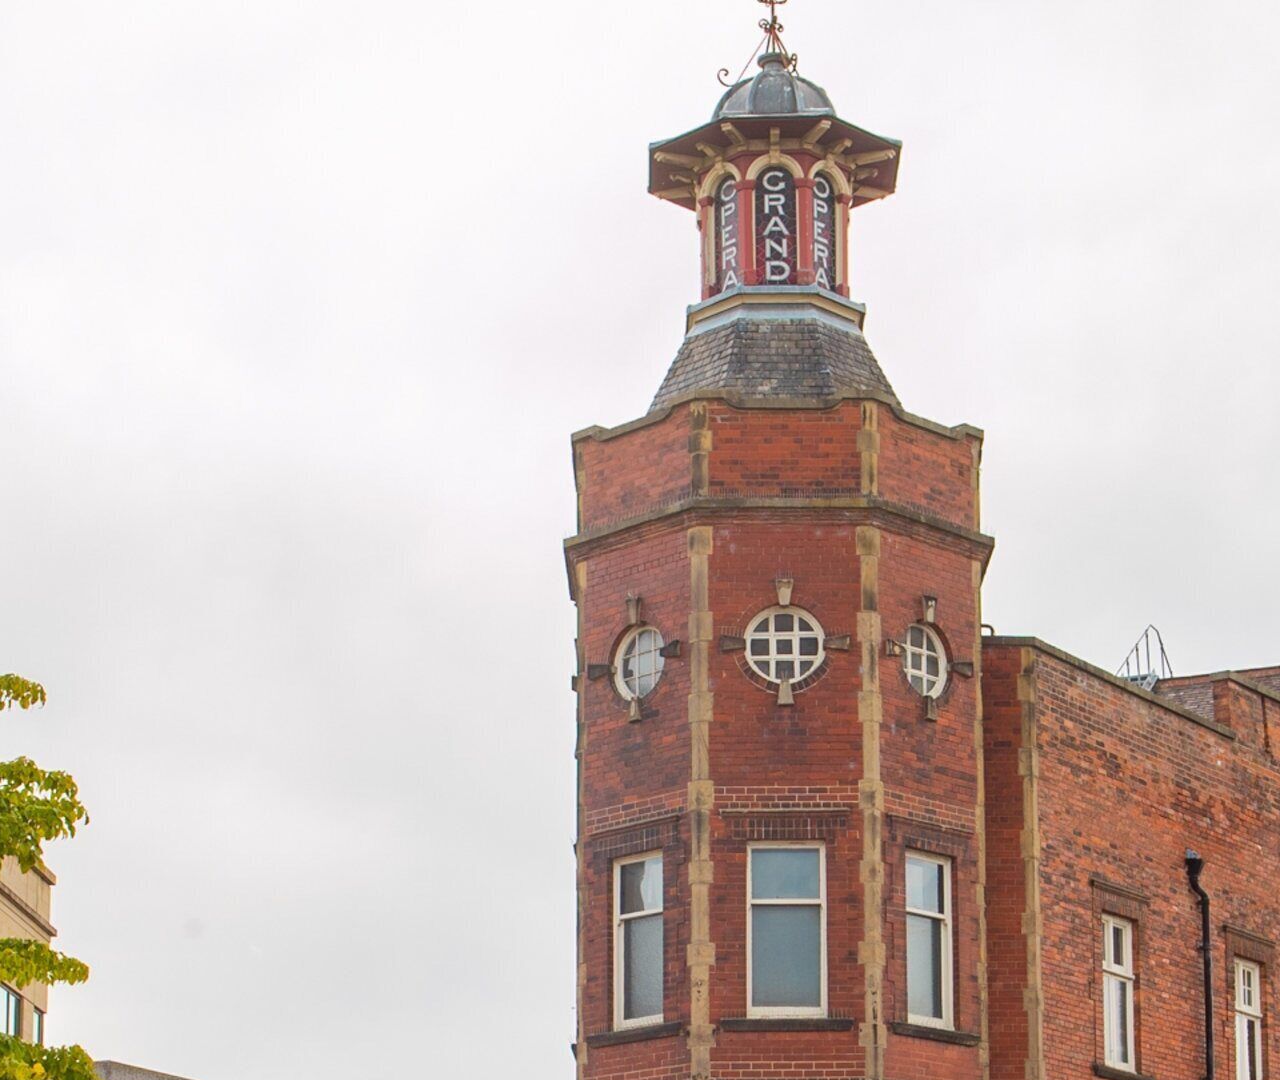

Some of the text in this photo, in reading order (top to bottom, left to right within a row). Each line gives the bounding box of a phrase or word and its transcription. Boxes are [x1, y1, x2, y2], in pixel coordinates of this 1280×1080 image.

[720, 179, 738, 292] OPERA
[761, 170, 790, 281] GRAND
[812, 176, 831, 290] OPERA
